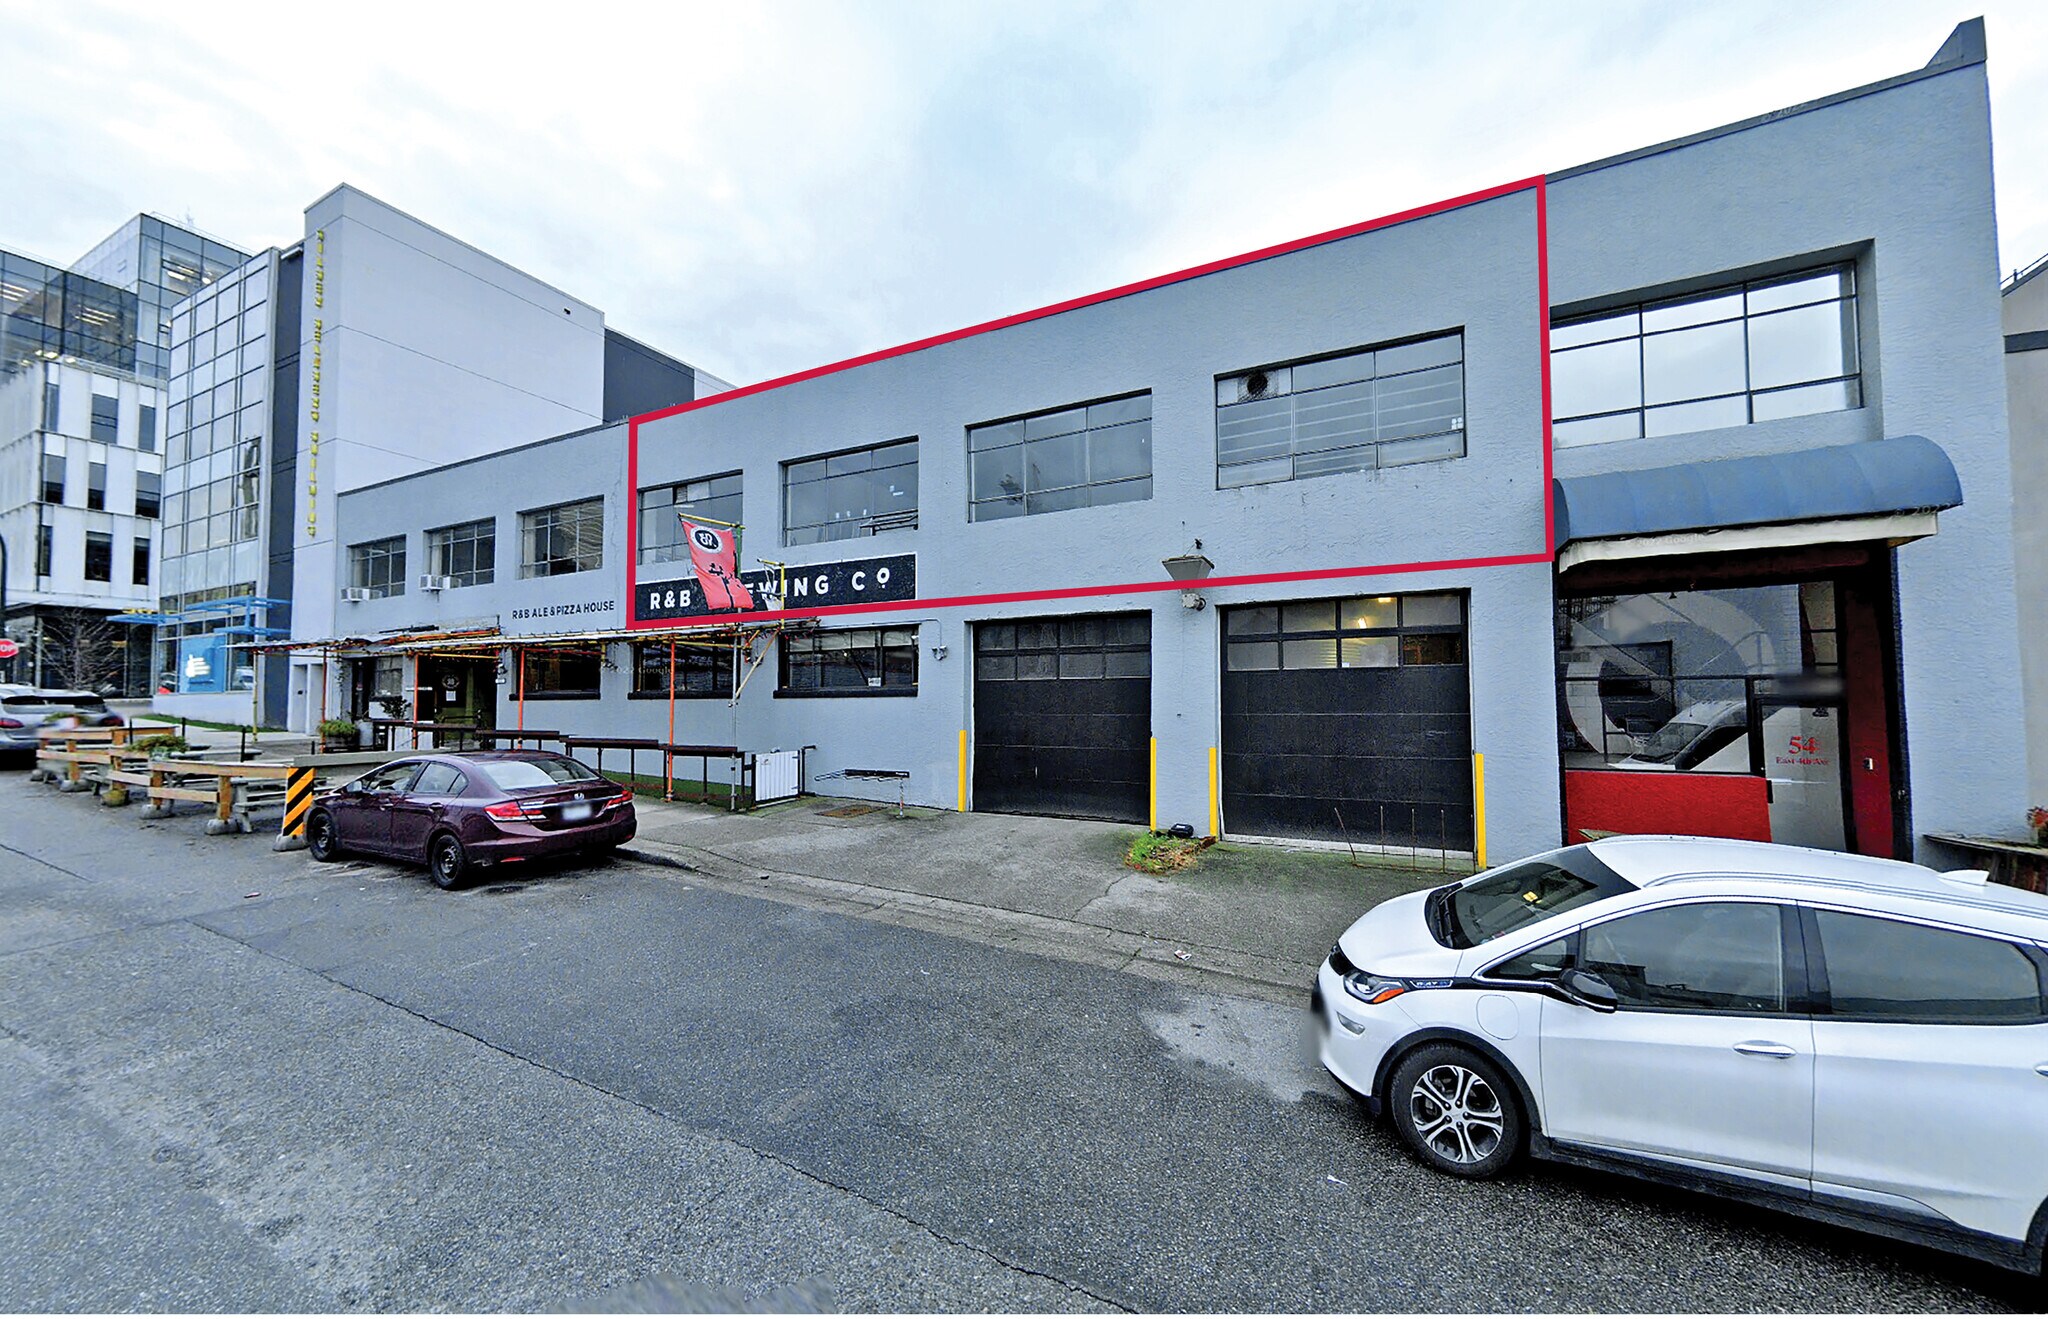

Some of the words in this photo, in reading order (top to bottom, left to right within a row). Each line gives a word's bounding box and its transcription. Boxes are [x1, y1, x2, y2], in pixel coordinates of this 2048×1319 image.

[512, 609, 530, 620] R&B
[532, 607, 548, 619] ALE
[556, 604, 582, 616] PIZZA
[583, 600, 614, 614] HOUSE
[650, 590, 691, 610] R&B
[1788, 735, 1820, 755] 54
